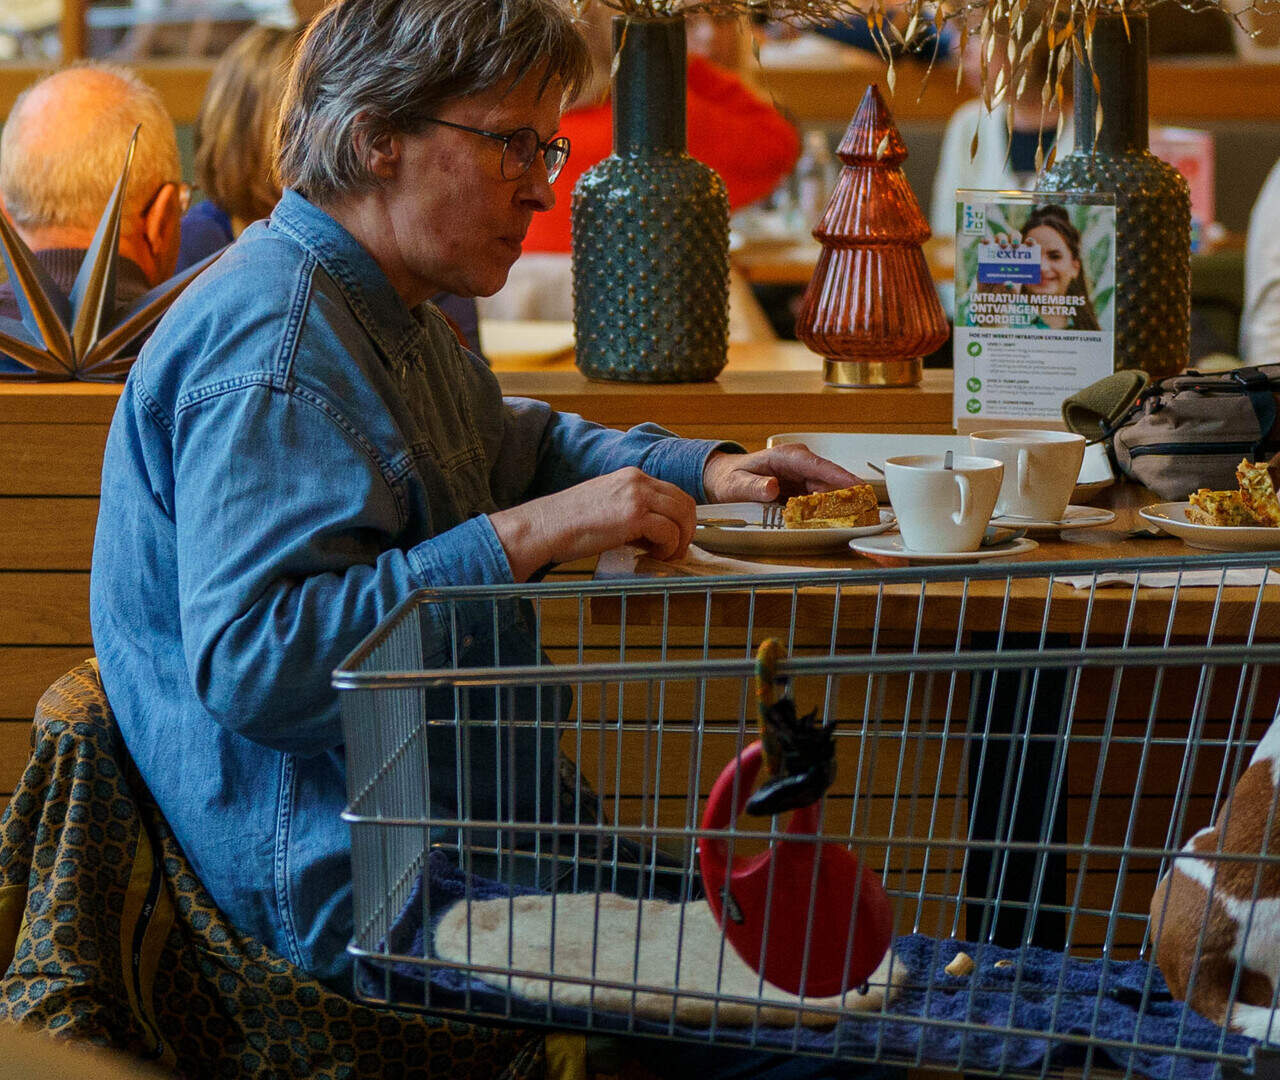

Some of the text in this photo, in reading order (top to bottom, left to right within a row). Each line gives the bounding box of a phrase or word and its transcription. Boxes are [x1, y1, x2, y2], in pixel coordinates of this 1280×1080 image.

[996, 248, 1032, 259] extra
[970, 292, 1086, 306] INTRATUIN MEMBERS
[969, 303, 1077, 316] ONTVANGEN EXTRA
[969, 313, 1031, 324] VOORDEEL!
